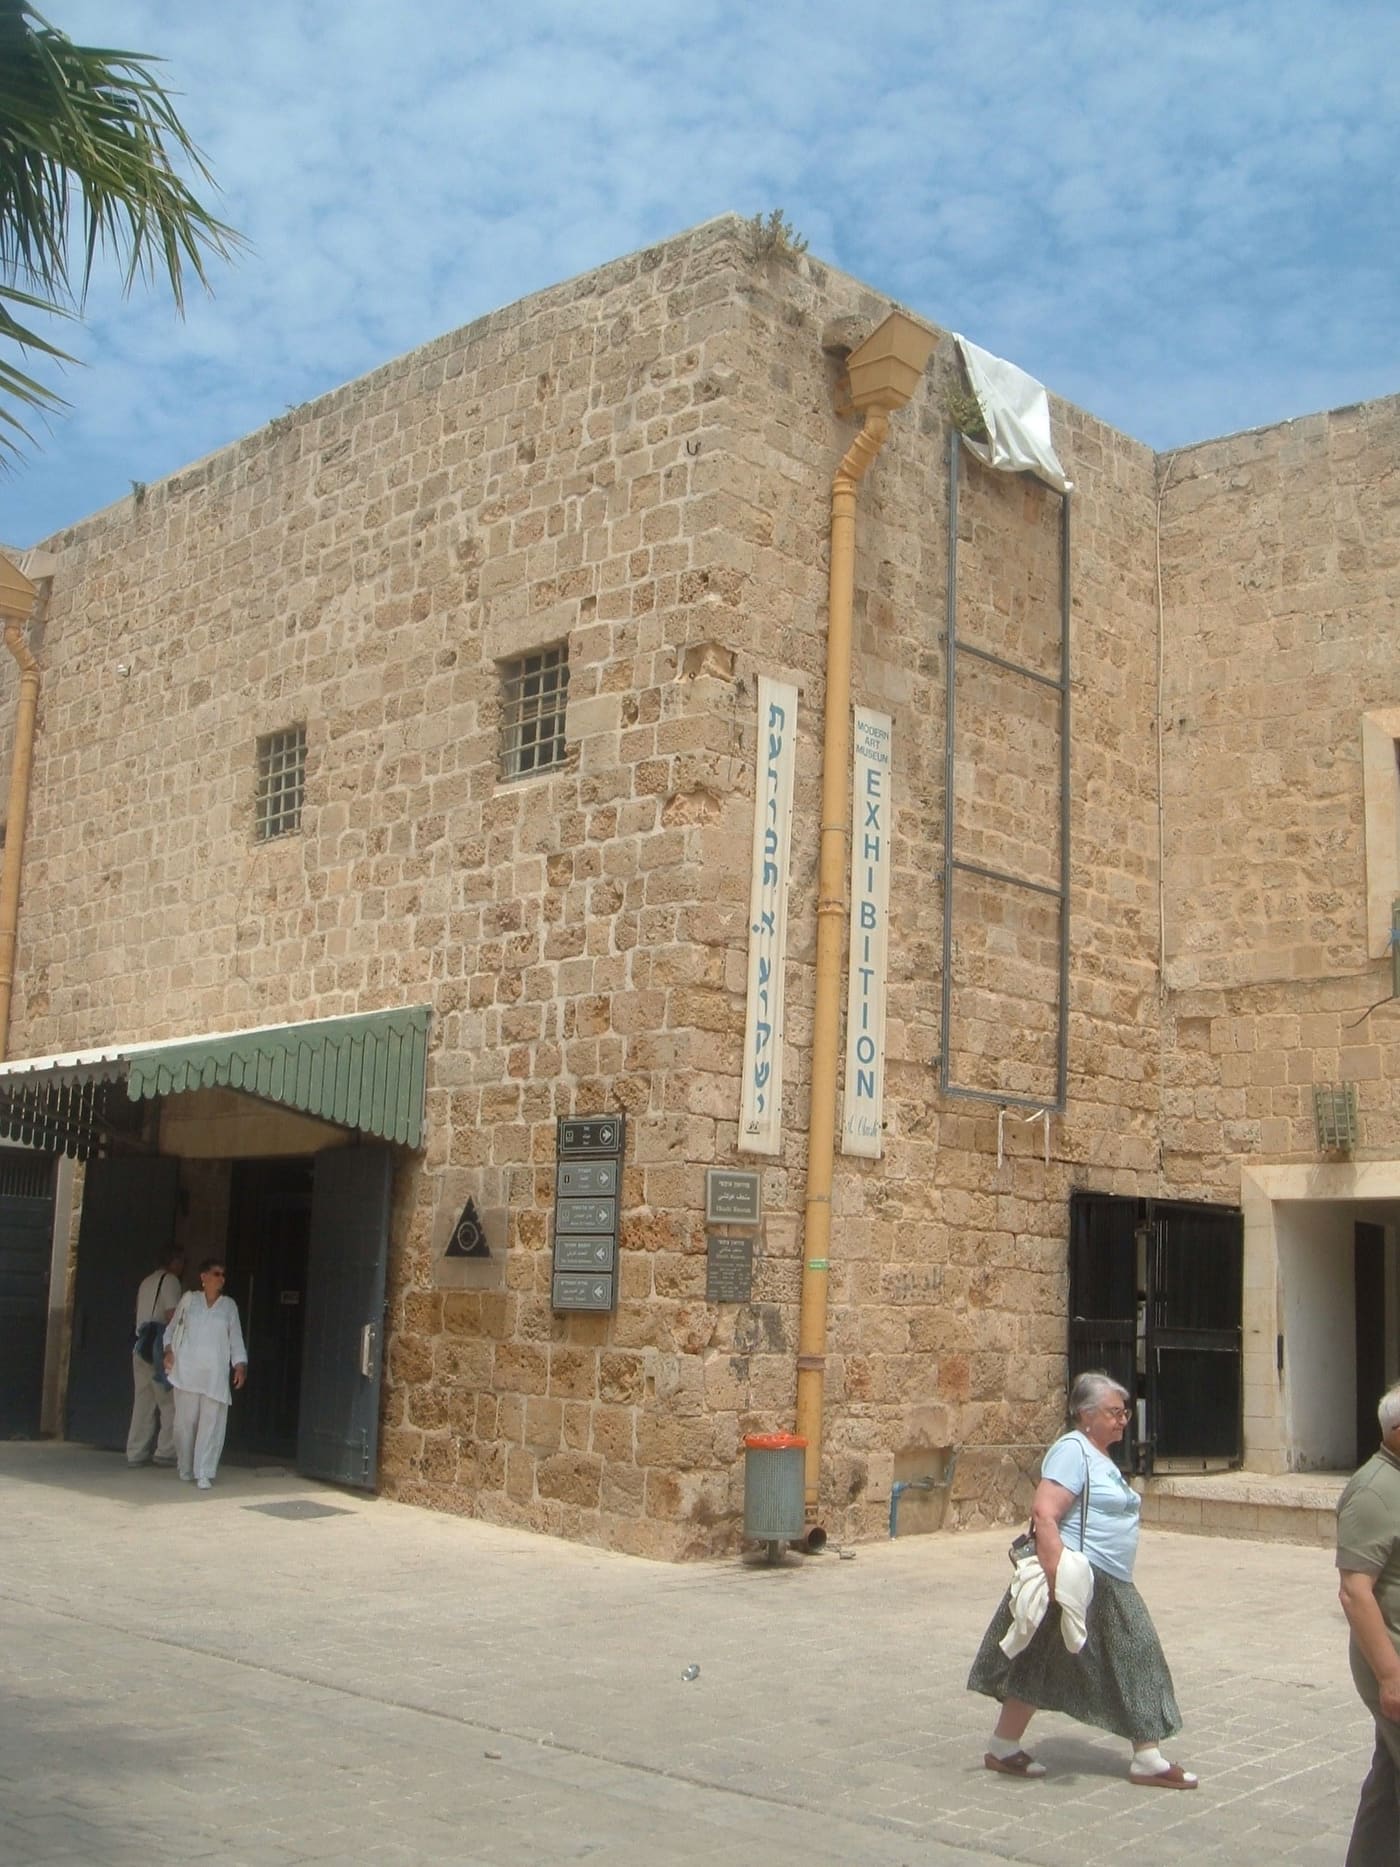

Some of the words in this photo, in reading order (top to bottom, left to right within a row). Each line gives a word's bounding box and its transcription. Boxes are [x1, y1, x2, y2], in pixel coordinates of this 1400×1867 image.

[855, 745, 889, 765] MUSEUM
[857, 720, 889, 741] MODERN
[864, 735, 881, 750] ART
[763, 702, 785, 888] תערוכת
[856, 768, 882, 1100] EXHIBITION
[755, 957, 773, 1114] עוקשי
